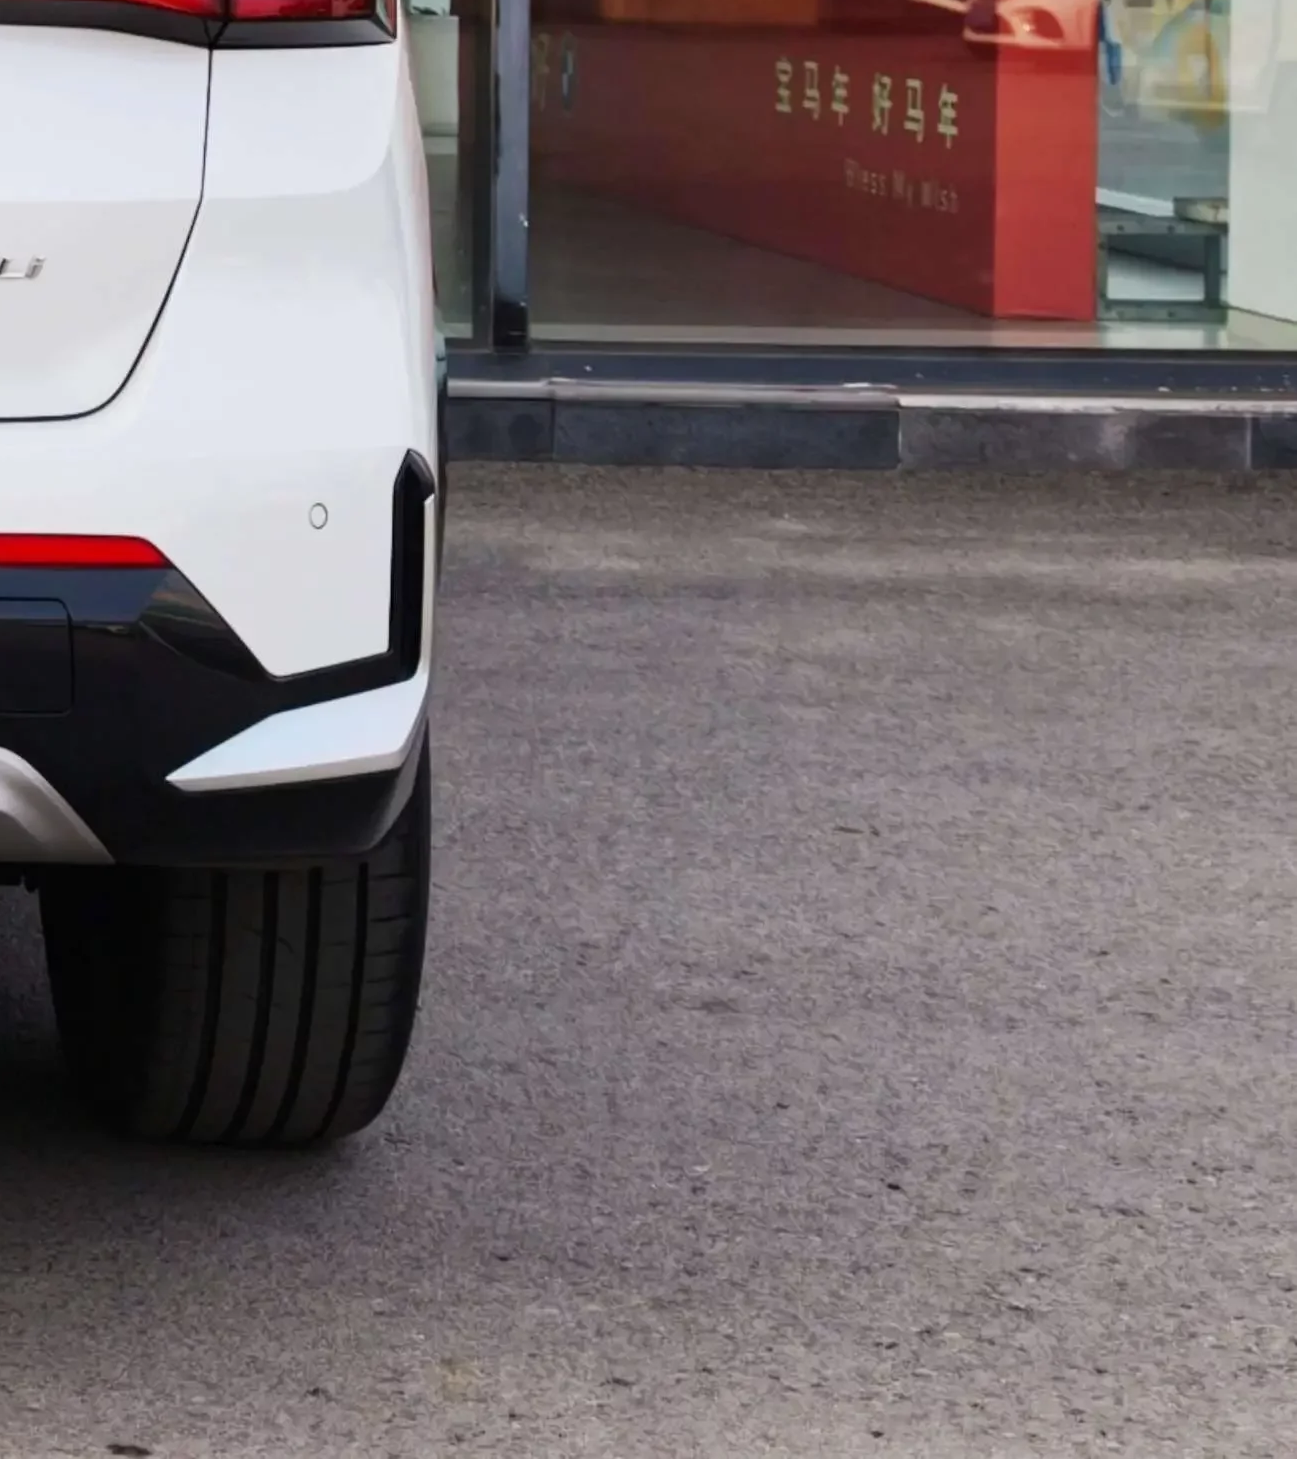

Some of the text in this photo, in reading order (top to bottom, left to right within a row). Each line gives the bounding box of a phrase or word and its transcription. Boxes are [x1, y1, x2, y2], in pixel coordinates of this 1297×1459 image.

[775, 57, 959, 149] 宝马年 好马年
